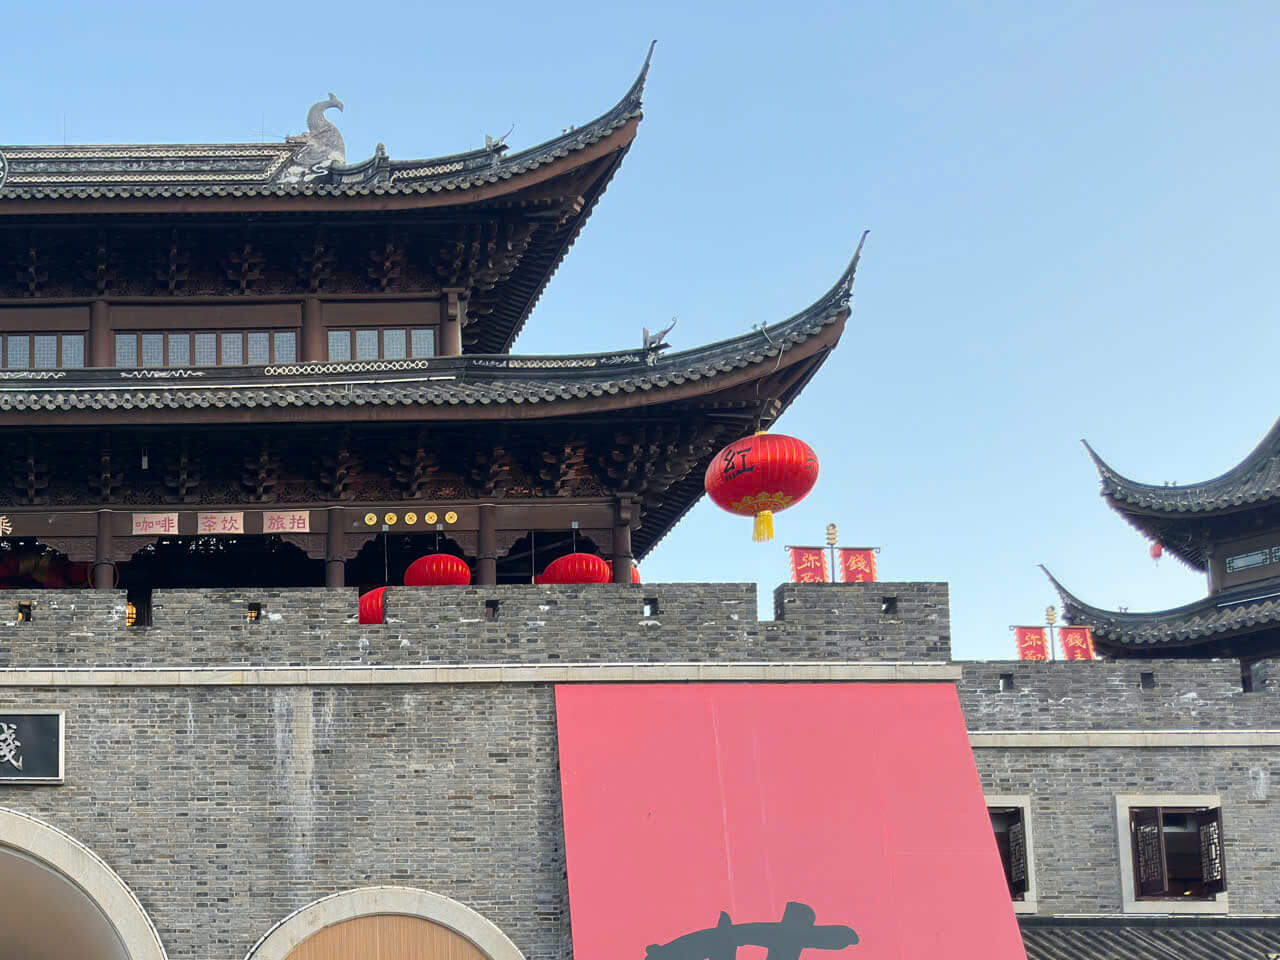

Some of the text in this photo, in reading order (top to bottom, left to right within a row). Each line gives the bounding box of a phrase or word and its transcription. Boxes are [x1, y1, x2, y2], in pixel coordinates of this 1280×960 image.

[135, 517, 175, 531] 咖啡
[201, 515, 240, 532] 茶饮
[268, 514, 307, 530] 旅拍
